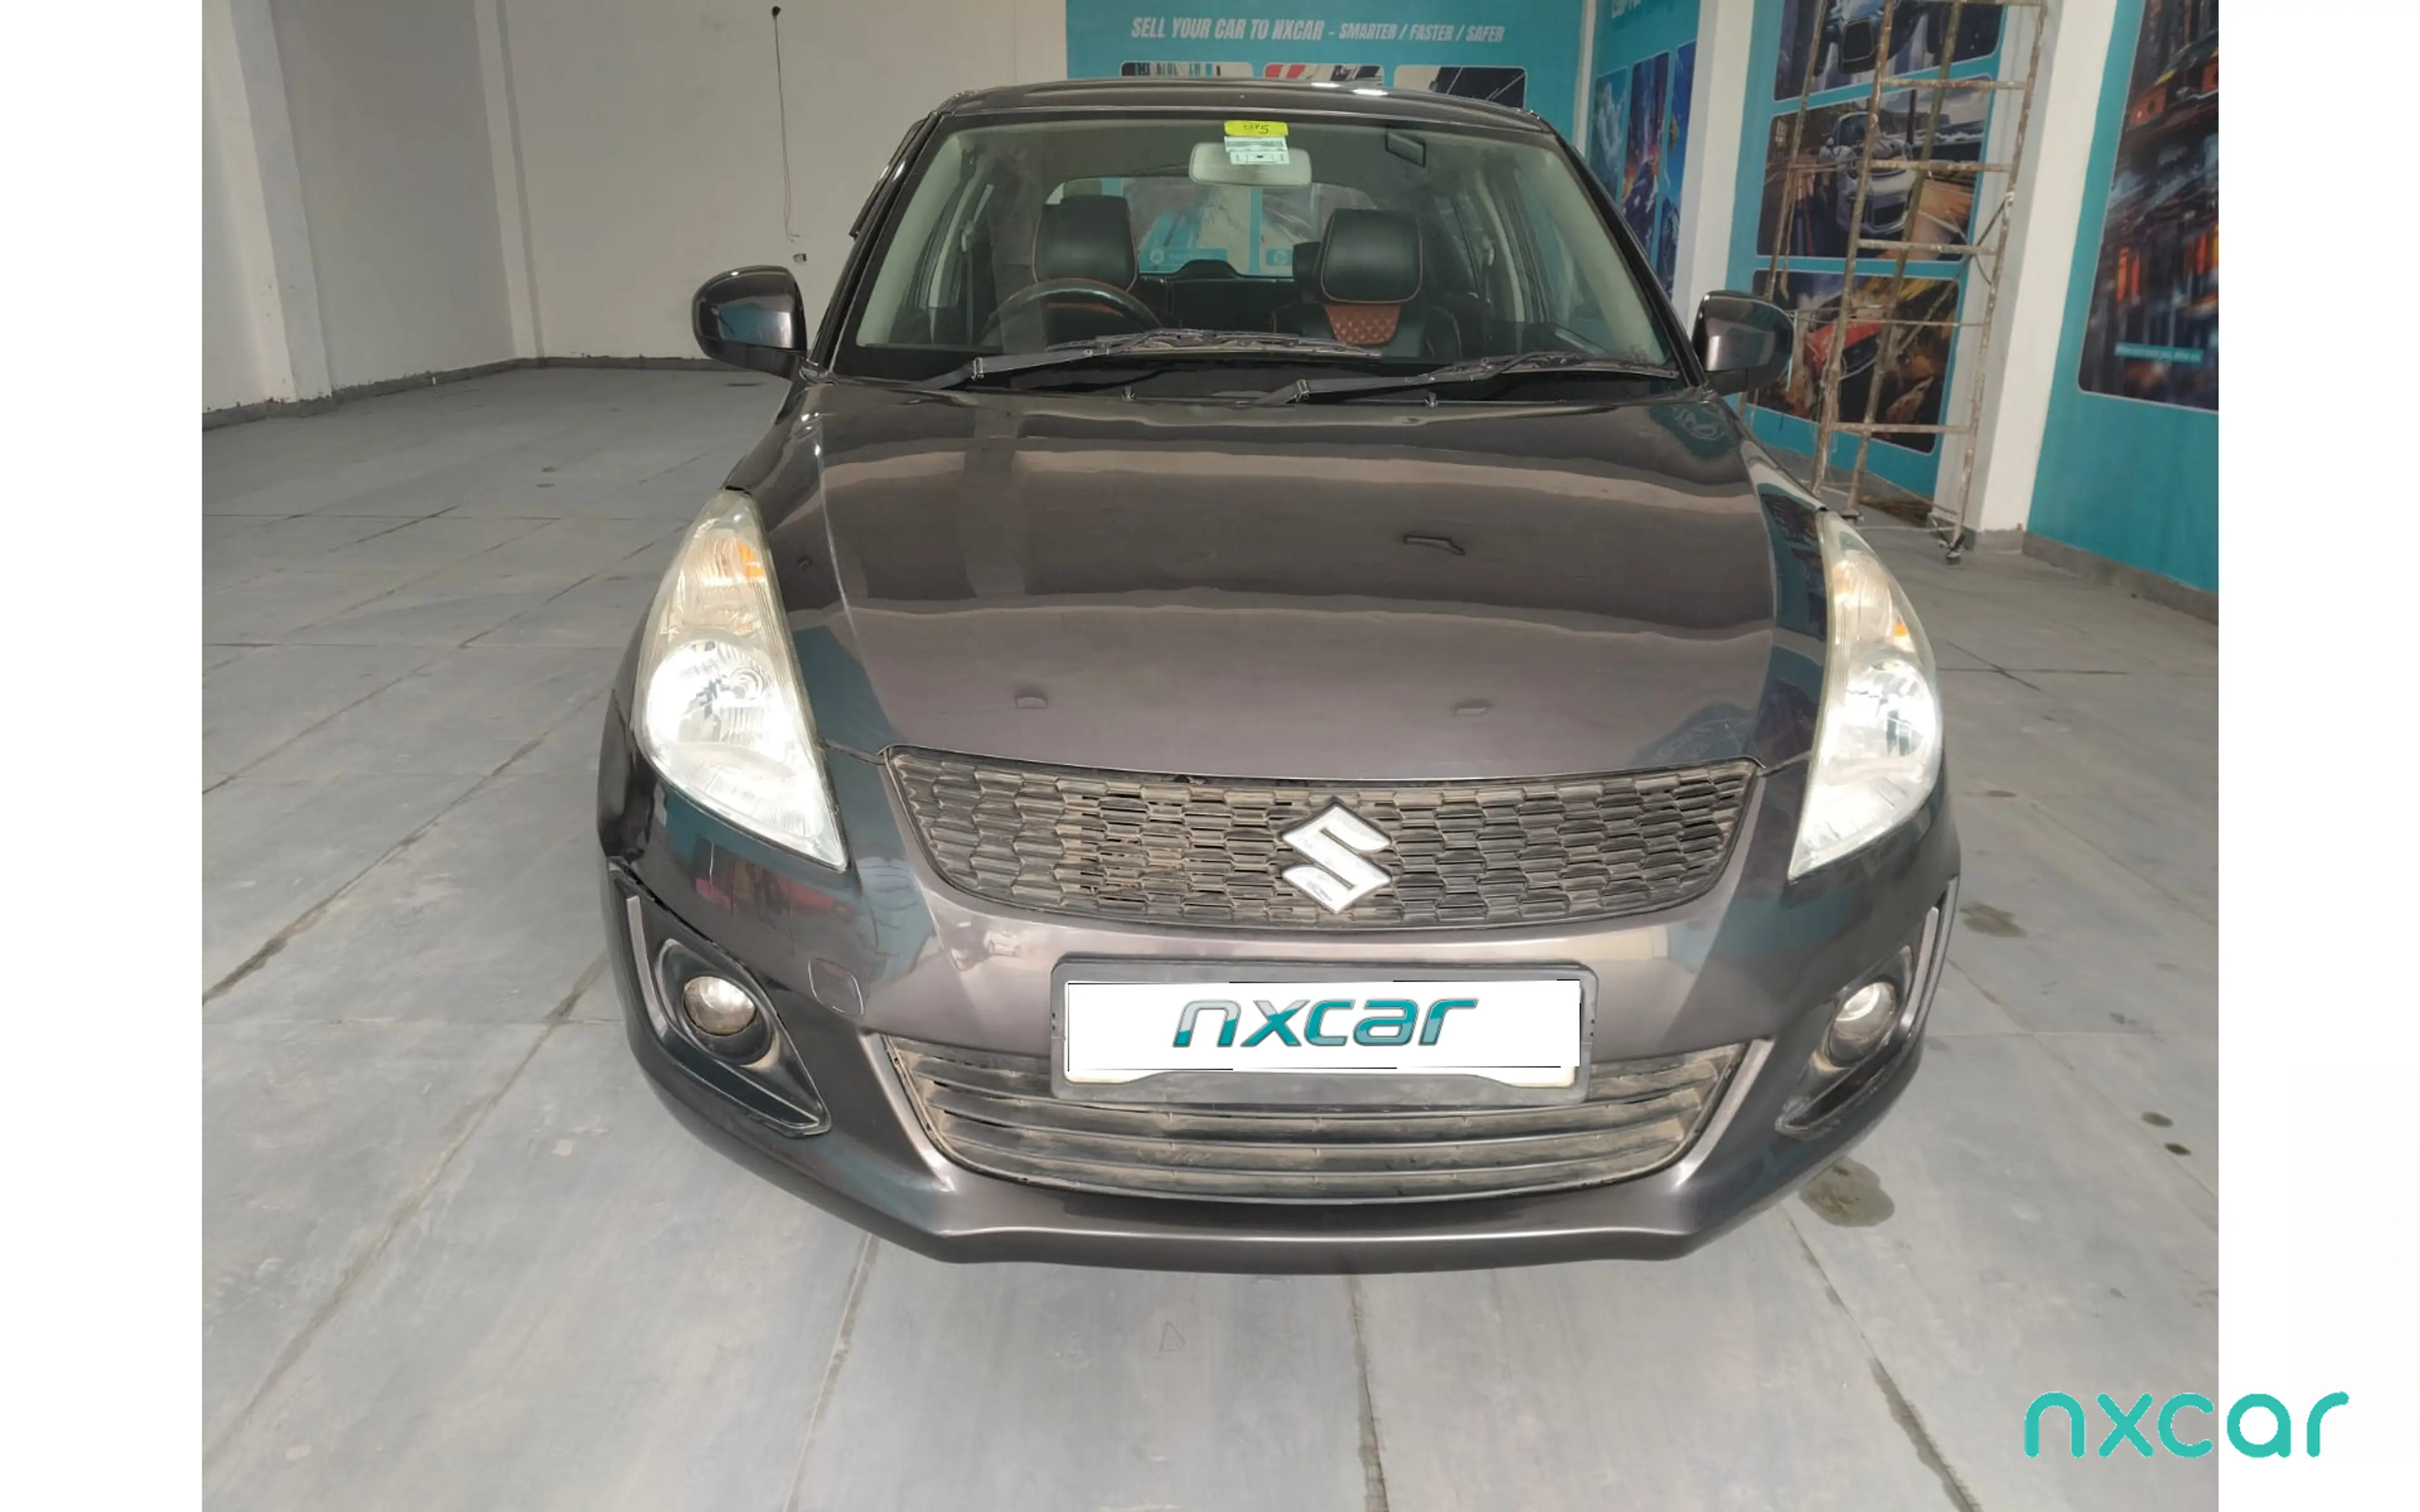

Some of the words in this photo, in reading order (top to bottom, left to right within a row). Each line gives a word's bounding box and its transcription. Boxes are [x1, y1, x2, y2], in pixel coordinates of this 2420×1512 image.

[1131, 16, 1166, 38] SELL
[1171, 16, 1212, 39] YOUR
[1214, 18, 1247, 40] CAR
[1249, 18, 1269, 40] TO
[1271, 19, 1325, 41] NXCAR
[1339, 23, 1398, 40] SMARTER
[1409, 23, 1455, 42] FASTER
[1466, 25, 1506, 43] SAFER
